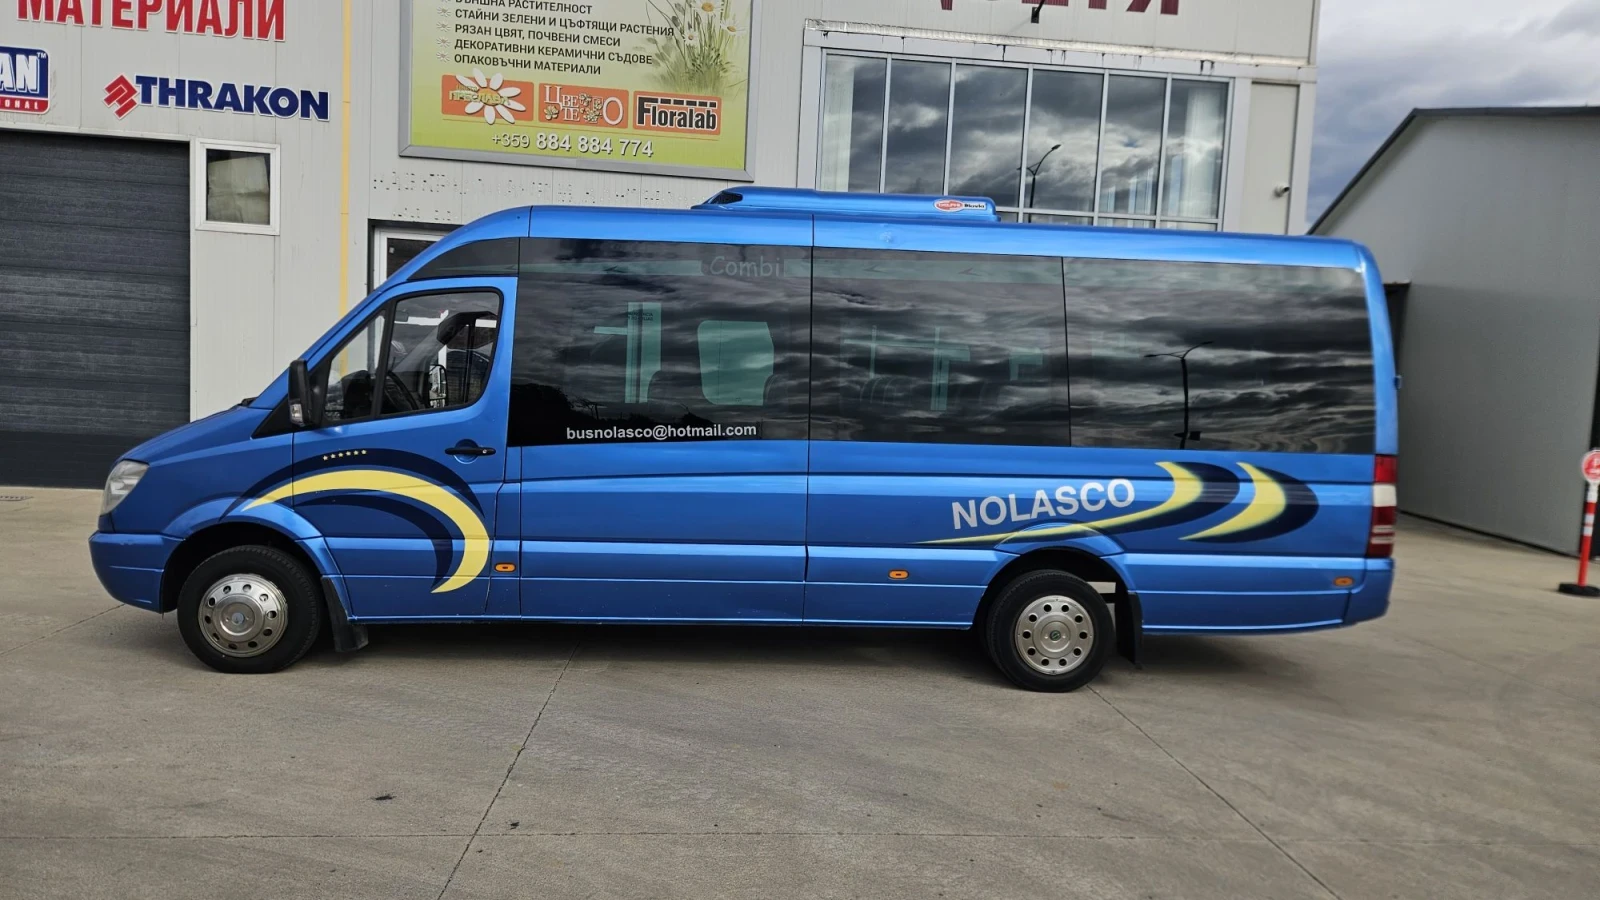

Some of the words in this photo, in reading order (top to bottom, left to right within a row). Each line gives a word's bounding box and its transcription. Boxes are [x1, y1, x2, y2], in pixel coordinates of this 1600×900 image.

[508, 0, 592, 14] РАСТИТЕЛНОСТ
[455, 9, 499, 21] СТАЙНИ
[502, 13, 546, 26] ЗЕЛЕНИ
[549, 18, 556, 26] И
[560, 18, 617, 32] ЦЪФТЯЩИ
[620, 23, 674, 36] РАСТЕНИЯ
[455, 24, 492, 36] РЯЗАН
[495, 27, 525, 40] ЦВЯТ,
[528, 30, 580, 43] ПОЧВЕНИ
[583, 35, 621, 47] СМЕСИ
[454, 39, 535, 55] ДЕКОРАТИВНИ
[538, 46, 605, 60] КЕРАМИЧНИ
[608, 52, 653, 65] СЪДОВЕ
[454, 54, 531, 69] ОПАКОВЪЧНИ
[534, 61, 601, 75] МАТЕРИАЛИ
[135, 75, 330, 121] THRAKON
[637, 96, 718, 131] Floralab
[492, 133, 530, 149] +359
[536, 132, 571, 152] 884
[577, 135, 613, 155] 884
[619, 139, 654, 157] 774
[709, 256, 780, 277] Combi
[566, 424, 757, 441] busnolasco@hotmail.com
[951, 478, 1136, 530] NOLASCO
